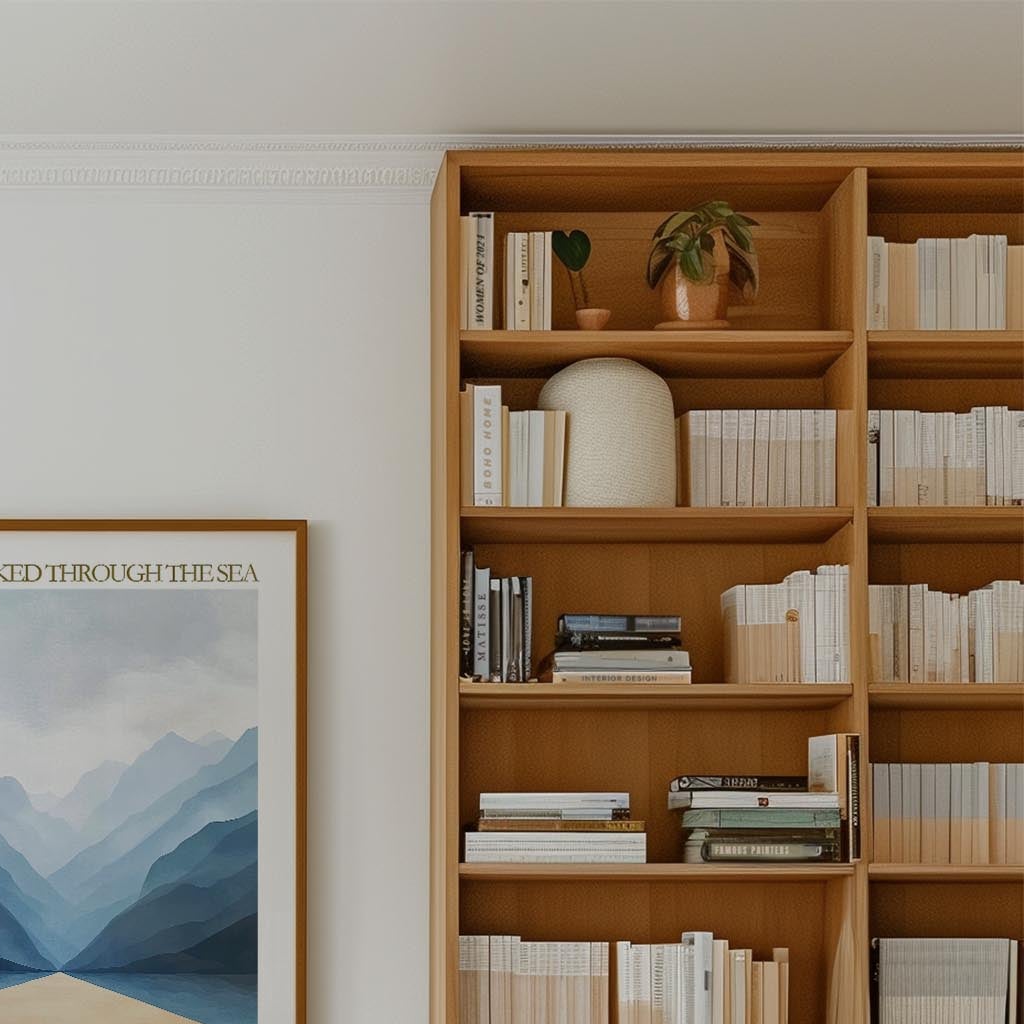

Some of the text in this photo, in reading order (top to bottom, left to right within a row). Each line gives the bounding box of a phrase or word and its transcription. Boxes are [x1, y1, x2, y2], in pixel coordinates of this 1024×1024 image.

[476, 260, 485, 276] OF
[475, 280, 485, 323] WOMEN
[483, 397, 492, 440] HOME
[483, 447, 492, 489] BOHO
[45, 563, 164, 583] THROUGH
[165, 563, 215, 583] THE
[216, 563, 260, 583] SEA
[477, 593, 487, 662] MATISSE
[714, 845, 789, 855] FAMOUS PAINTERS
